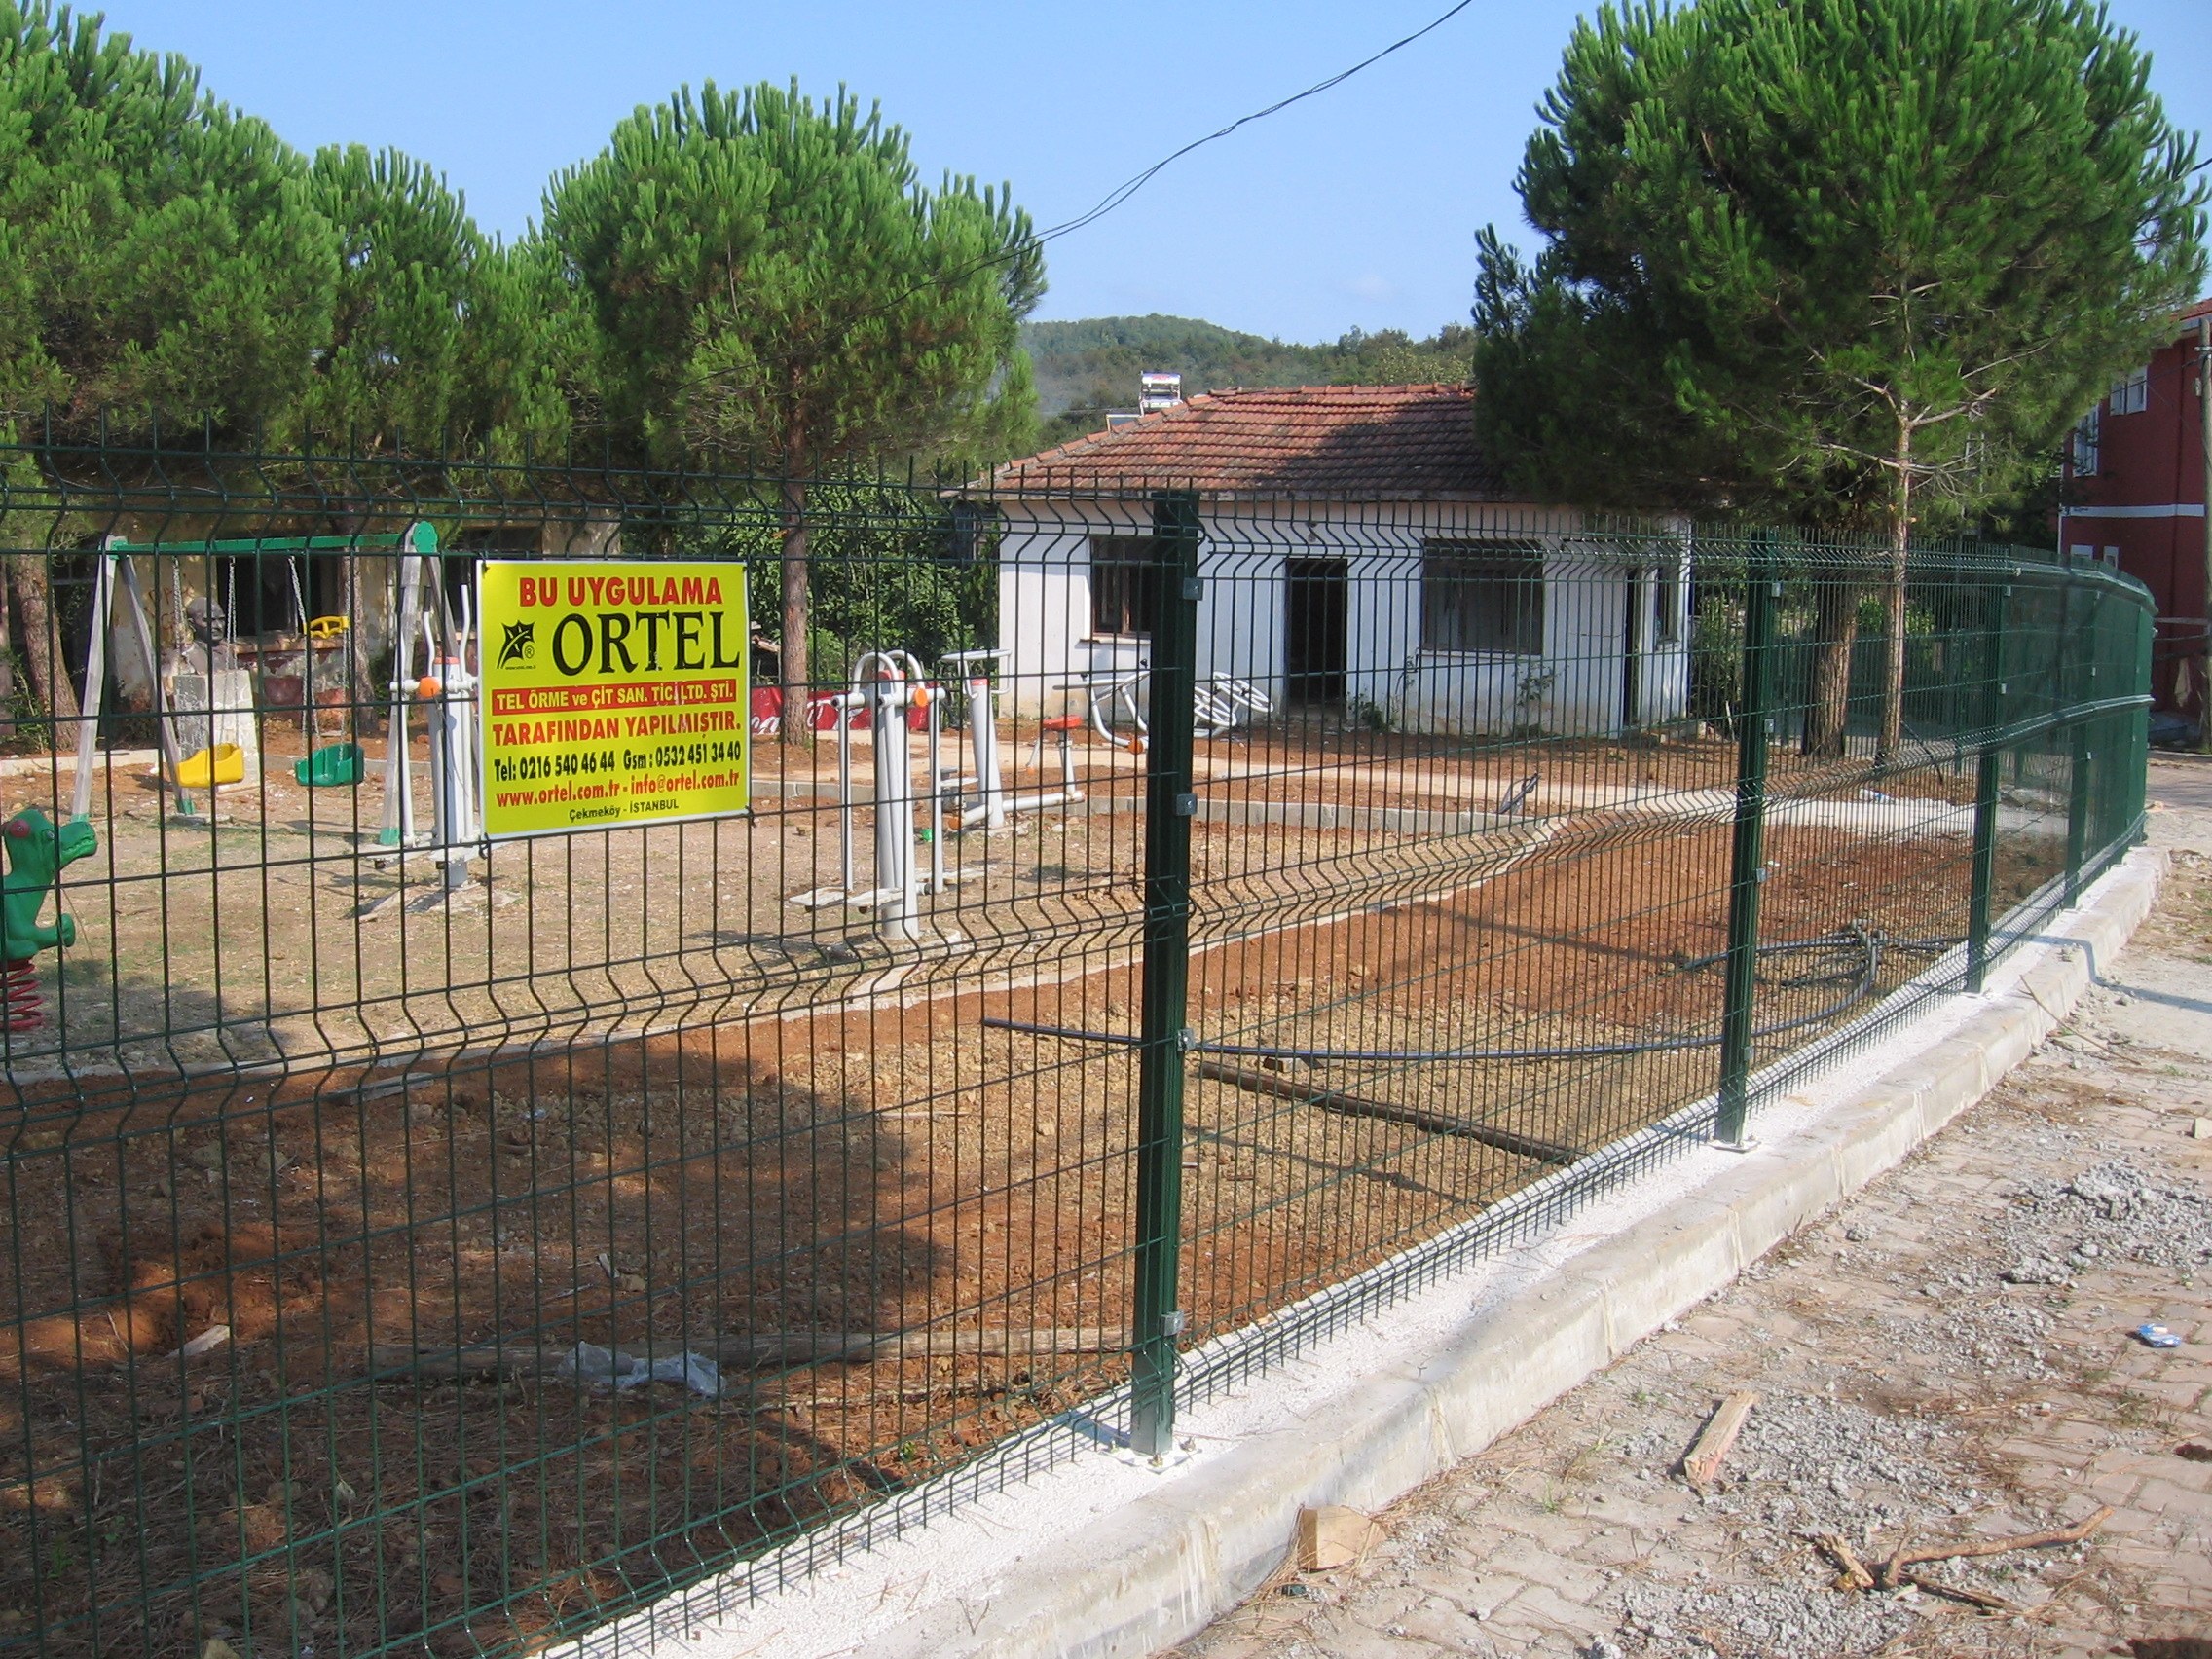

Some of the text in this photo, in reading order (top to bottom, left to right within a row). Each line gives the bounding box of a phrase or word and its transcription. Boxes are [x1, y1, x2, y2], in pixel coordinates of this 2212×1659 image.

[519, 576, 723, 608] BU UYGULAMA
[552, 610, 740, 677] ORTEL
[497, 693, 525, 711] TEL
[528, 689, 569, 709] ÖRME
[572, 694, 588, 706] ve
[591, 685, 614, 709] ÇİT
[617, 687, 648, 704] SAN.
[680, 684, 707, 701] LTD.
[710, 680, 733, 702] ŞTİ.
[492, 717, 619, 747] TARAFINDAN
[624, 710, 741, 739] YAPILMIŞTIR.
[494, 756, 516, 782] Tel:
[519, 756, 551, 780] 0216
[554, 753, 578, 777] 540
[581, 752, 597, 774] 46
[599, 750, 615, 772] 44
[623, 748, 647, 770] Gsm
[655, 744, 685, 767] 0532
[687, 743, 707, 764] 451
[711, 741, 724, 763] 34
[727, 740, 741, 761] 40
[496, 779, 621, 808] www.ortel.com.tr
[630, 769, 740, 795] info@ortel.com.tr
[569, 805, 621, 823] Çekmeköy
[629, 798, 679, 814] İSTANBUL
